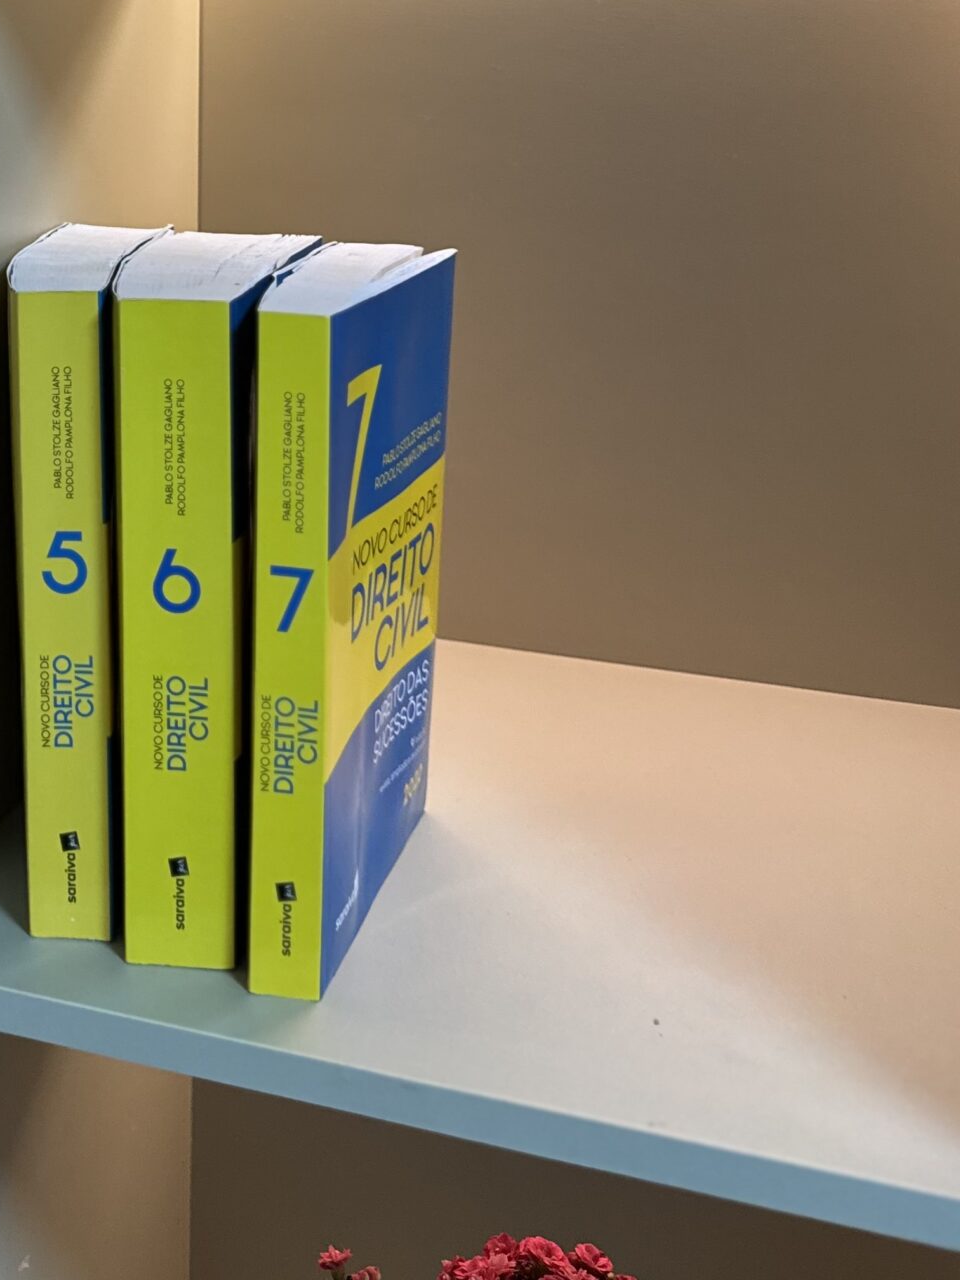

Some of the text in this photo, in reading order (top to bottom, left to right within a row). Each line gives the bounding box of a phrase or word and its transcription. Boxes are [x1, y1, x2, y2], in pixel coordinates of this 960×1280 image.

[51, 366, 62, 489] PABLO STOLZE GAGLIANO
[63, 366, 74, 499] RODOLFO PAMPLONA FILHO
[163, 378, 173, 505] PABLO STOLZE GAGLIANO
[176, 378, 186, 516] RODOLFO PAMPLONA FILHO
[282, 391, 293, 521] PABLO STOLZE GAGLIANO
[295, 392, 306, 533] RODOLFO PAMPLONA FILHO
[346, 364, 382, 535] 7
[41, 531, 88, 594] 5
[352, 483, 438, 576] NOVO CURSO DE
[153, 548, 201, 614] 6
[269, 564, 314, 633] 7
[351, 522, 435, 644] DIREITO
[374, 582, 428, 672] CIVIL
[40, 655, 51, 748] NOVO CURSO DE
[52, 655, 74, 748] DIREITO
[75, 655, 94, 717] CIVIL
[153, 674, 164, 770] NOVO CURSO DE
[166, 675, 187, 771] DIREITO
[188, 677, 209, 741] CIVIL
[297, 700, 319, 764] CIVIL
[373, 688, 428, 764] SUCESSÕES
[374, 679, 406, 733] DIREITO
[407, 659, 430, 694] DAS
[259, 694, 271, 792] NOVO CURSO DE
[273, 696, 296, 794] DIREITO
[65, 852, 77, 903] saraiva
[173, 877, 186, 930] saraiva
[279, 903, 292, 956] saraiva
